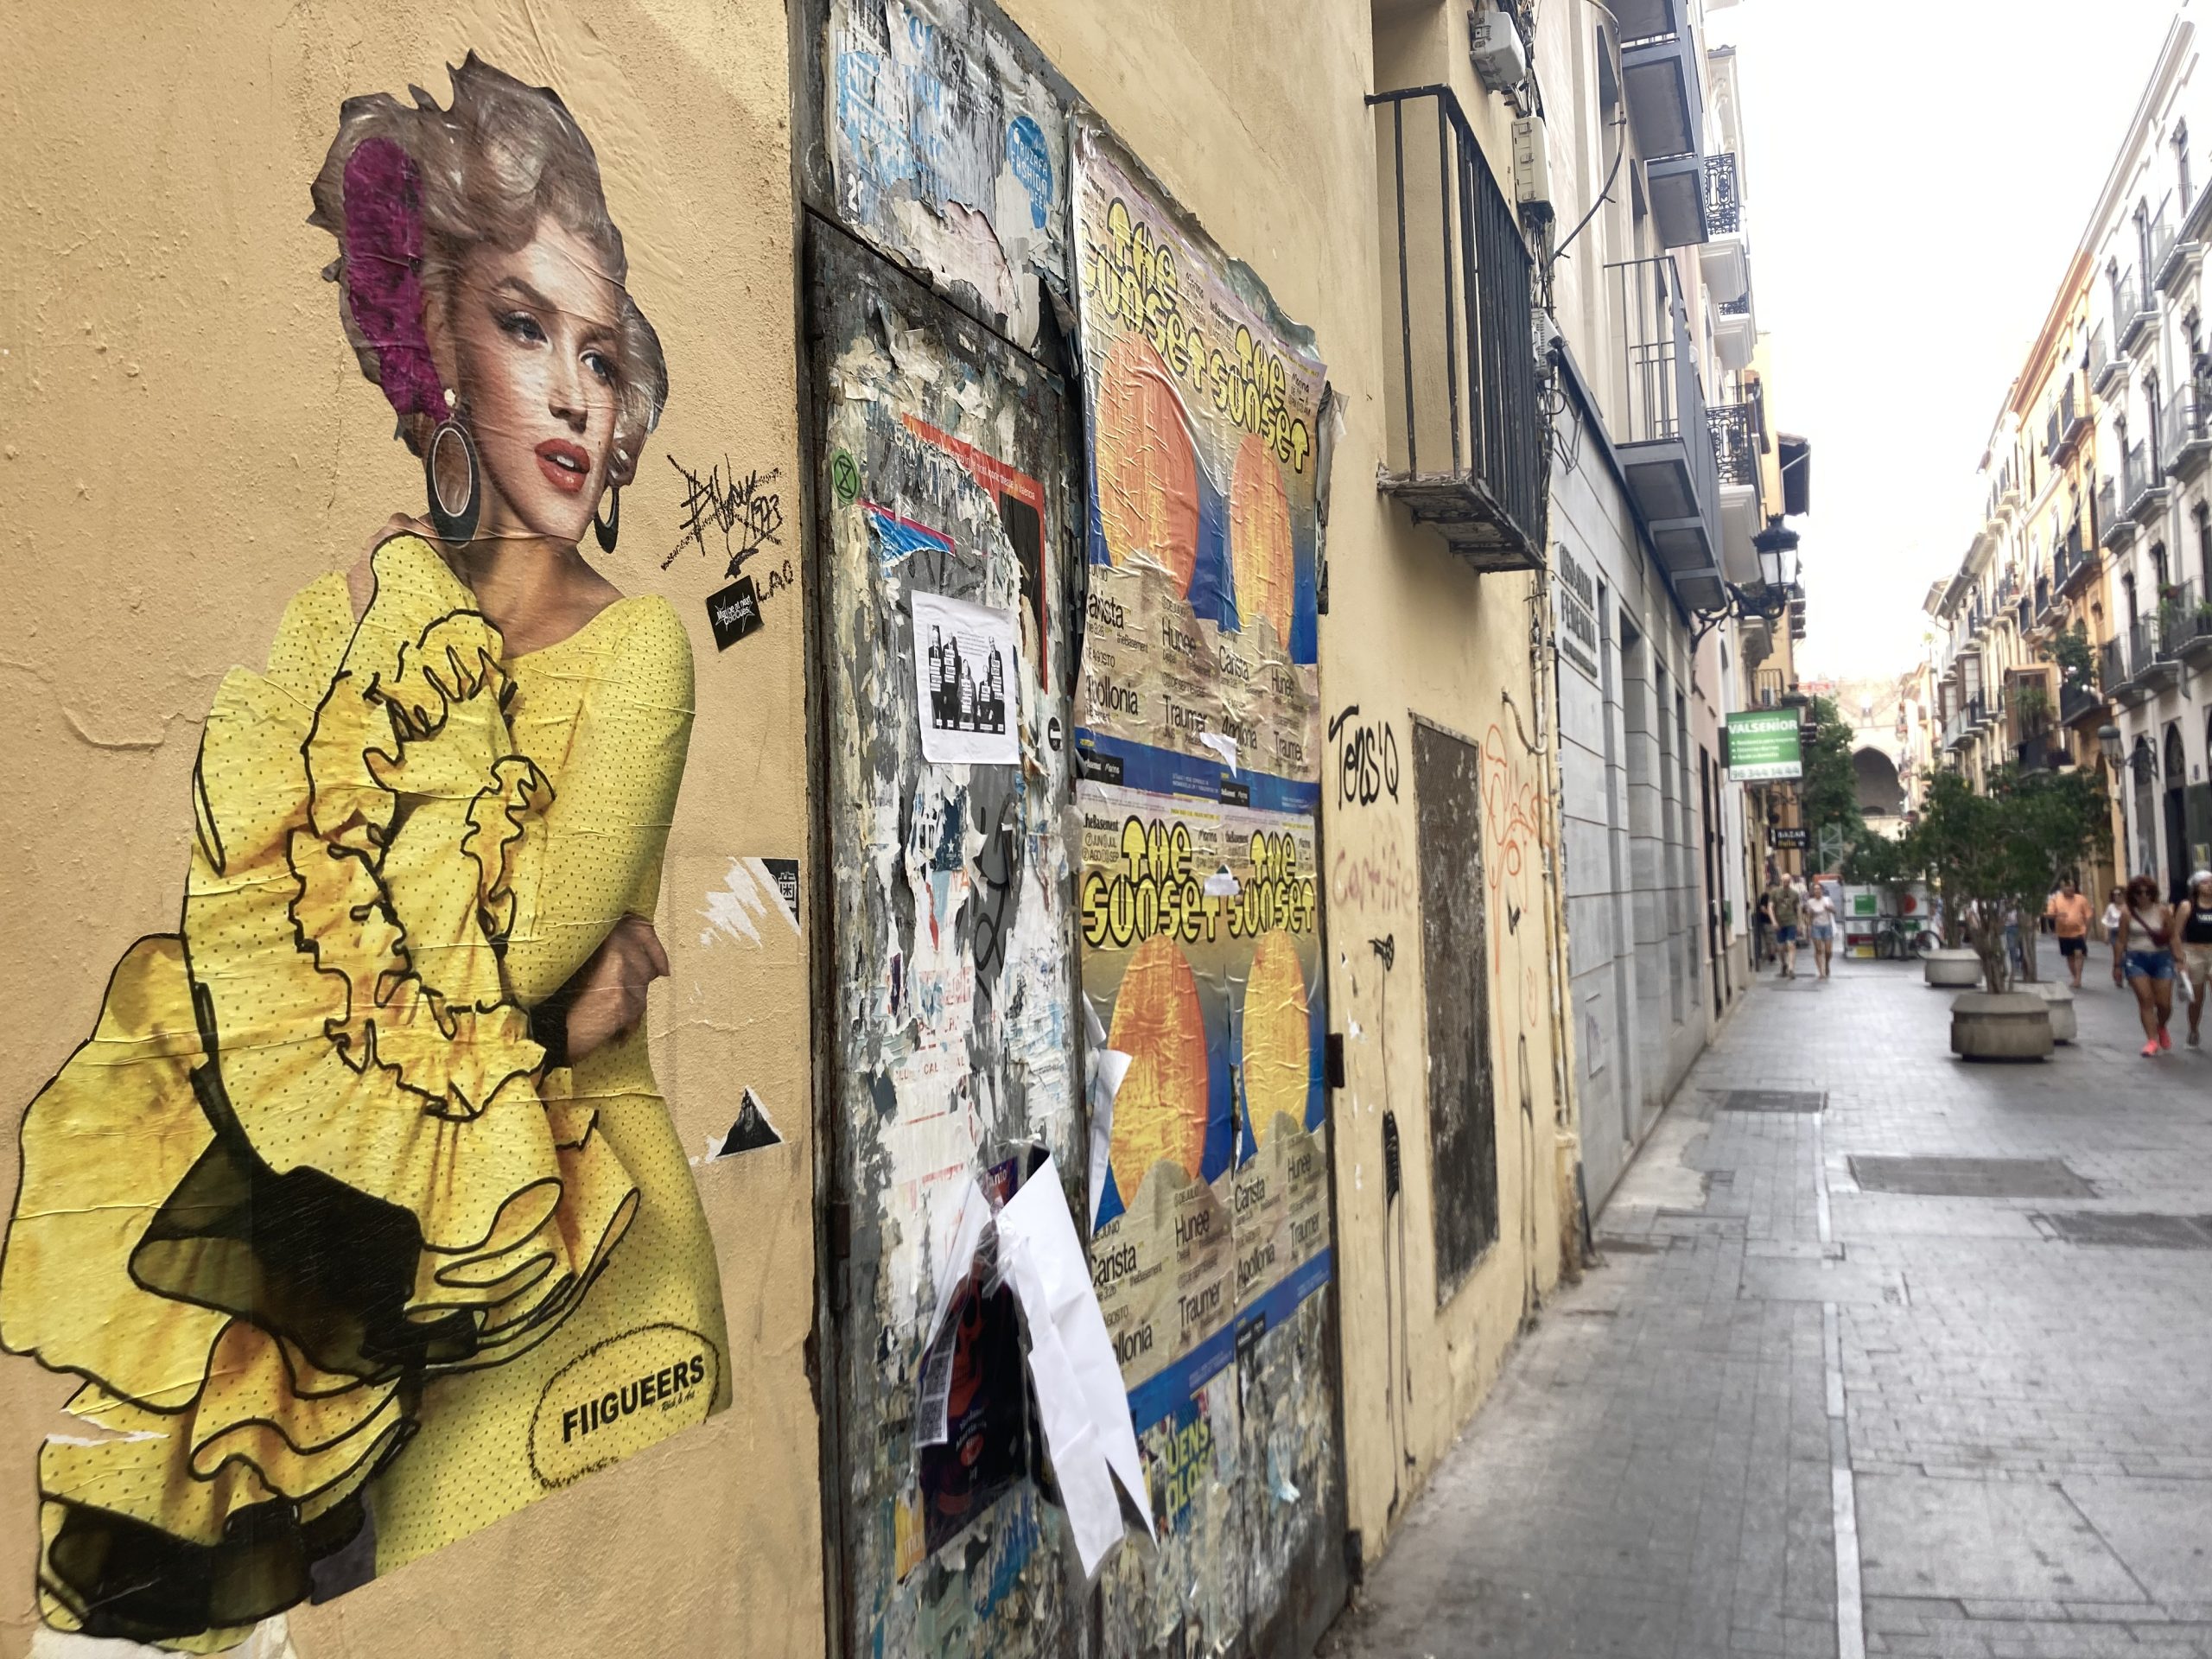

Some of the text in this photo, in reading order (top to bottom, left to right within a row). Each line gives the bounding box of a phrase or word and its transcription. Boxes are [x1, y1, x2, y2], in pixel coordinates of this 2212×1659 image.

[1010, 151, 1048, 196] FASHION
[1020, 141, 1048, 177] RUZAFA
[1085, 590, 1123, 630] arista
[1728, 719, 1797, 734] VALSENIOR
[1175, 1210, 1210, 1248] Hunee
[563, 1354, 704, 1444] FIIGUEERS
